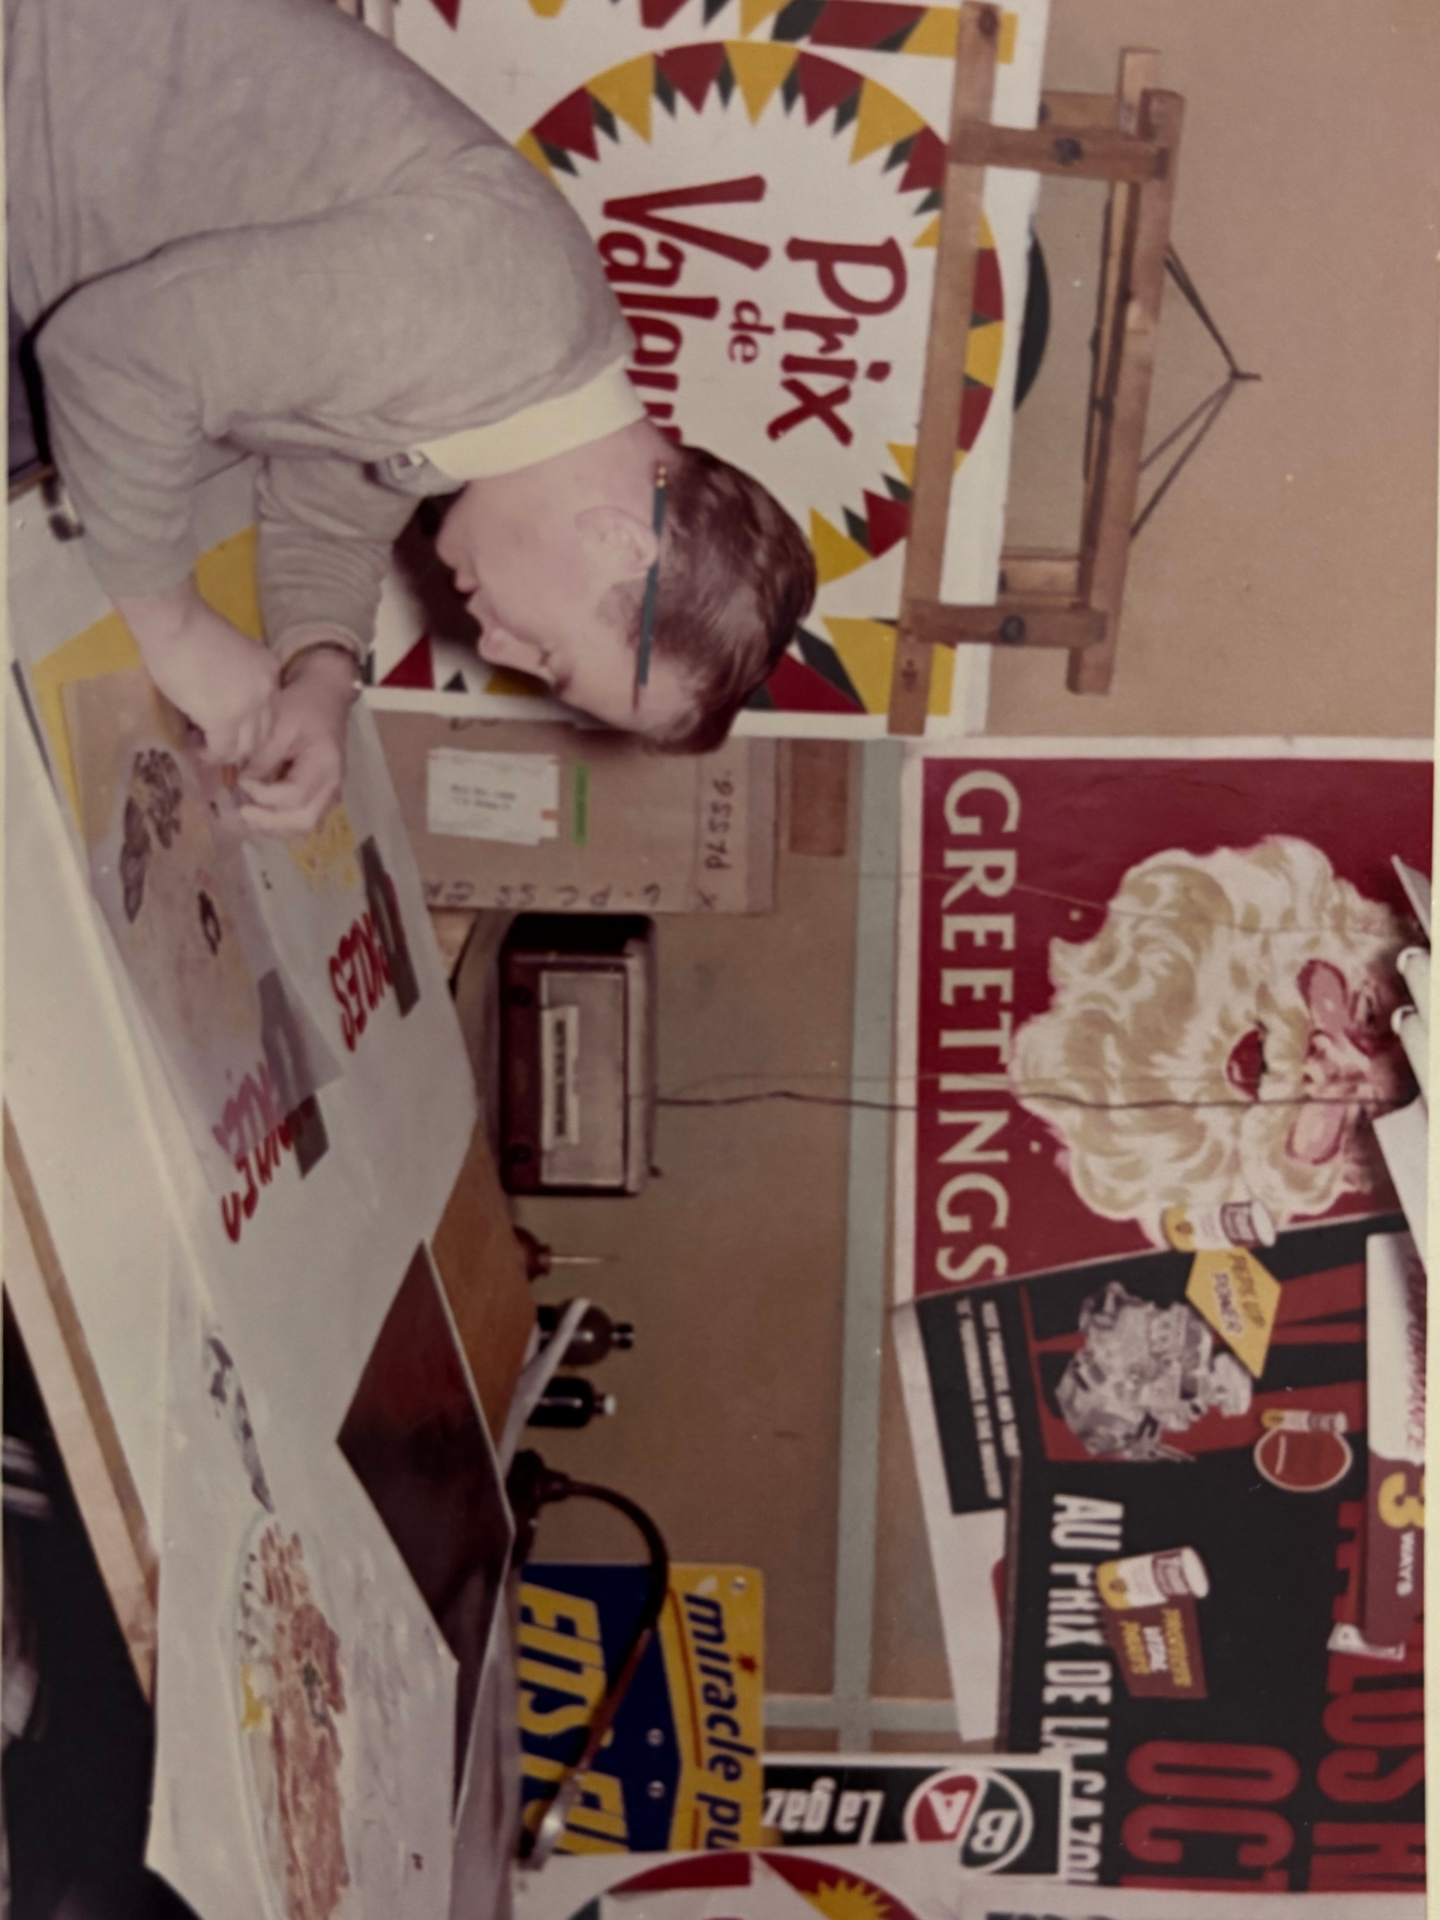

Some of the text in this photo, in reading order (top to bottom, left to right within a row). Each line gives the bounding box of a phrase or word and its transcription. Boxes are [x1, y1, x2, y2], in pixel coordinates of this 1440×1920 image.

[728, 300, 776, 364] de
[766, 237, 908, 447] Prix
[936, 769, 1021, 1283] GREETINGS
[1212, 1273, 1244, 1334] POWER
[1050, 1494, 1124, 1551] AU
[1396, 1530, 1416, 1597] WAYS
[1045, 1561, 1106, 1649] PRIX
[517, 1580, 614, 1748] FITS
[684, 1593, 755, 1783] miracle
[1042, 1660, 1112, 1706] DE
[1040, 1716, 1110, 1757] LA
[833, 1789, 885, 1846] La
